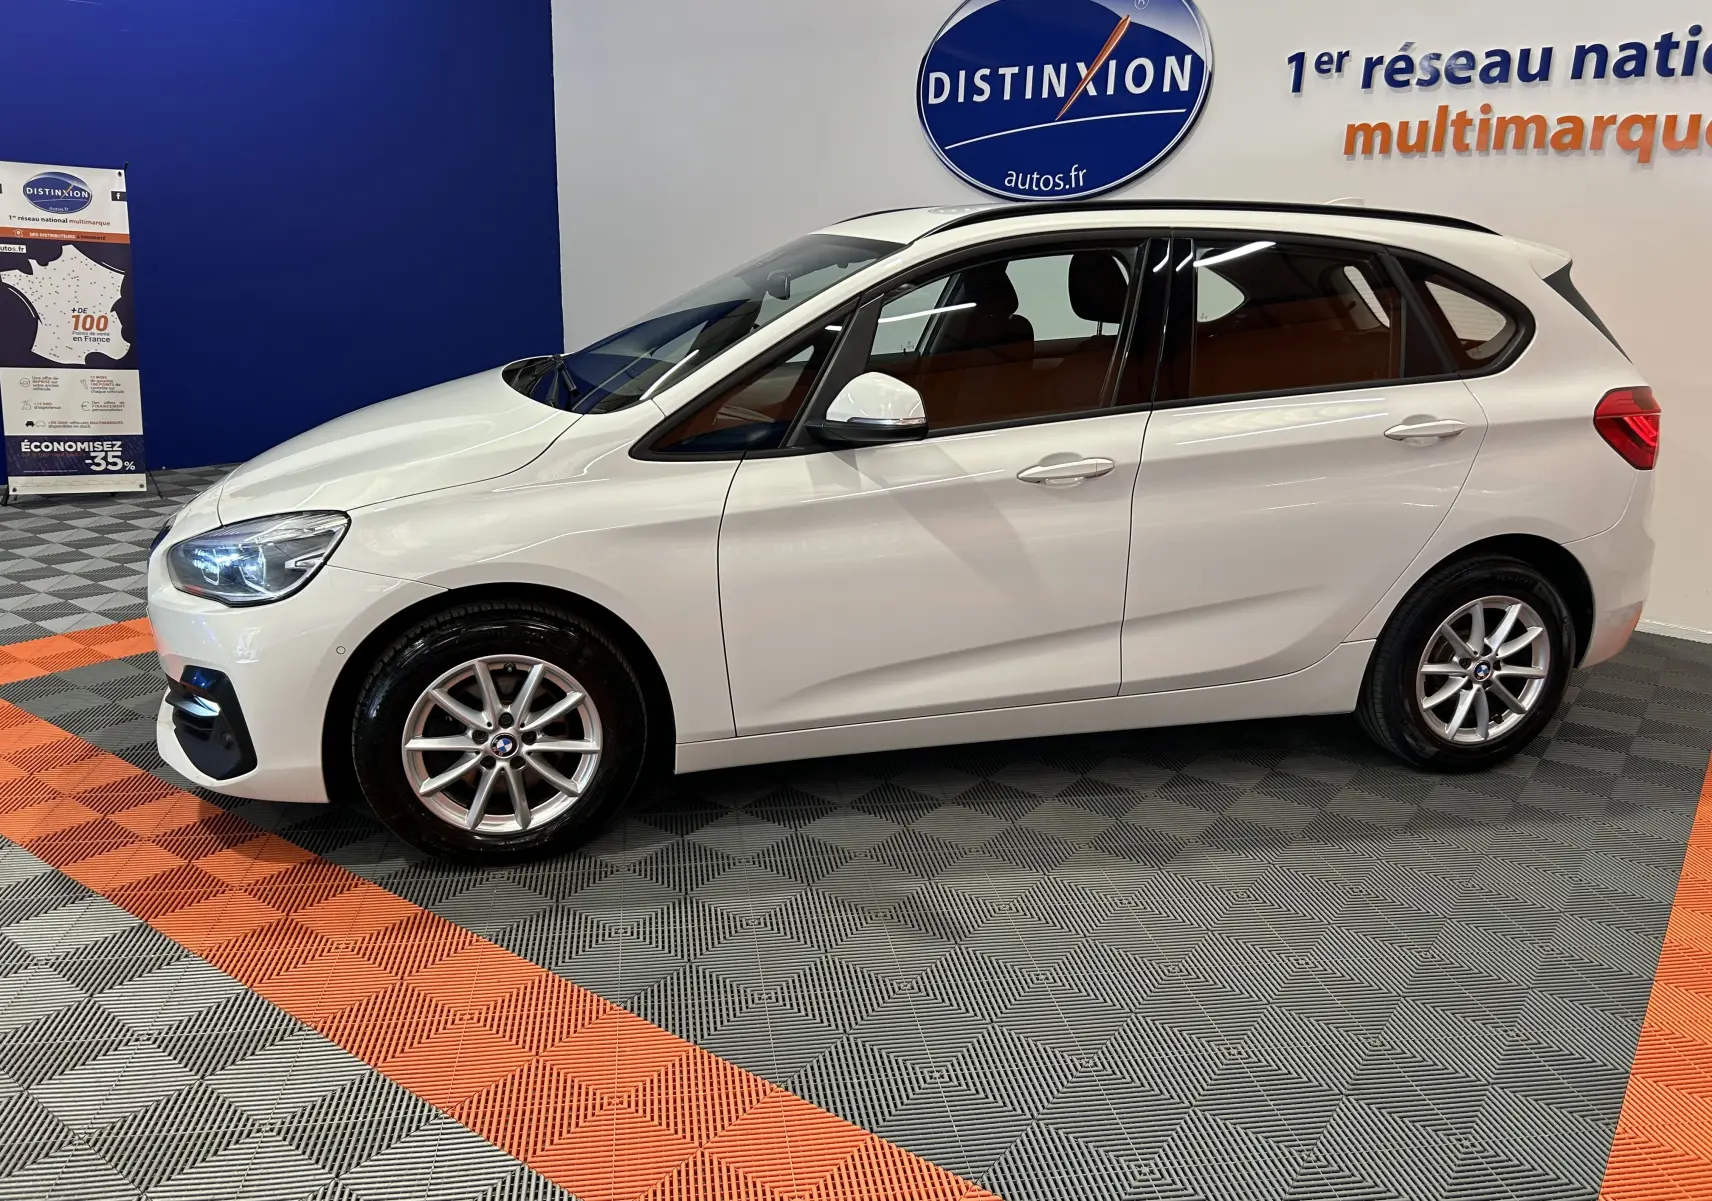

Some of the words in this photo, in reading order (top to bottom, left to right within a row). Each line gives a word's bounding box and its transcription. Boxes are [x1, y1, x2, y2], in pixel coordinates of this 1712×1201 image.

[1287, 50, 1350, 94] 1er
[1361, 42, 1553, 89] réseau
[1570, 24, 1712, 80] nati
[927, 54, 1192, 105] DISTINXION
[1343, 103, 1712, 164] multimarqu
[1004, 164, 1086, 191] autos.fr
[26, 187, 88, 198] DISTINXION
[41, 216, 68, 224] national
[69, 218, 110, 226] multimarque
[71, 314, 109, 332] 100
[21, 439, 122, 452] ÉCONOMISEZ
